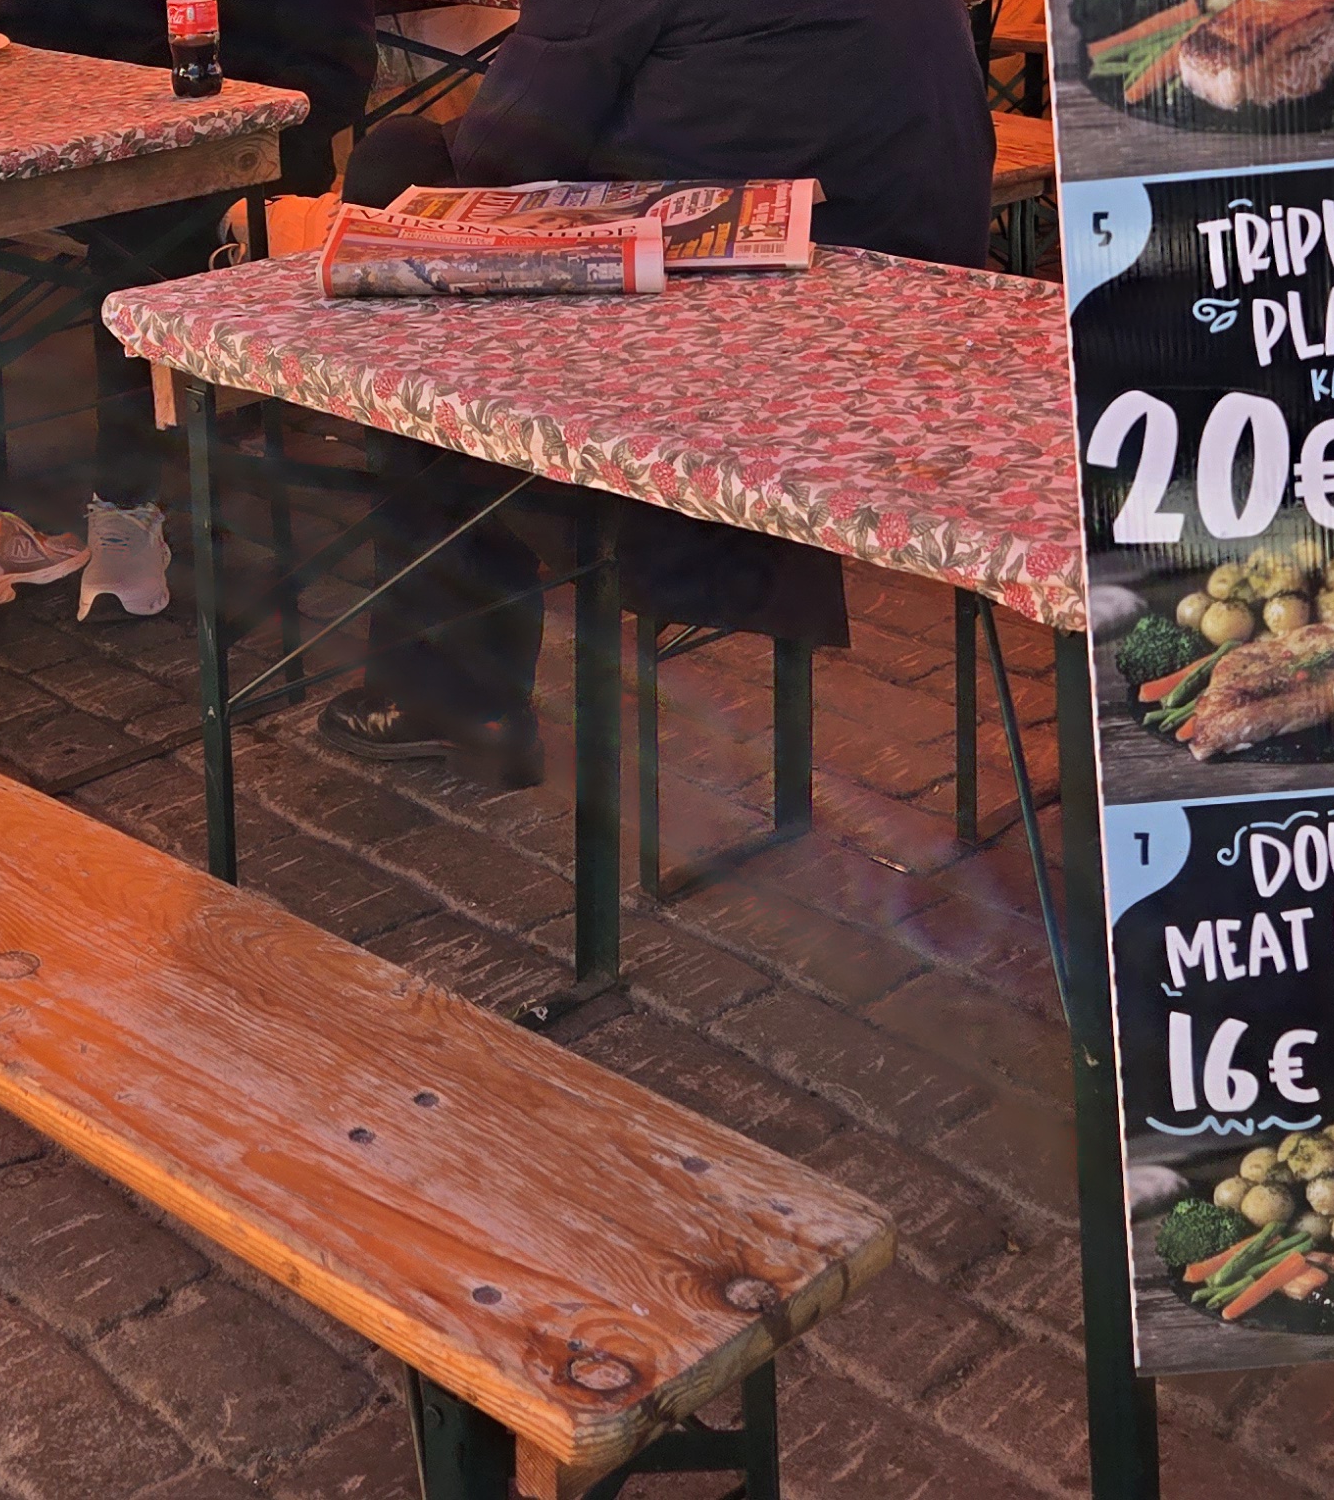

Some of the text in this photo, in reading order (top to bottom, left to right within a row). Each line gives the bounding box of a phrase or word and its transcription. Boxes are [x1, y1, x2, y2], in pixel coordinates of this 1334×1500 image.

[1092, 211, 1110, 247] 5
[1134, 832, 1150, 865] 7
[1165, 907, 1315, 989] MEAT
